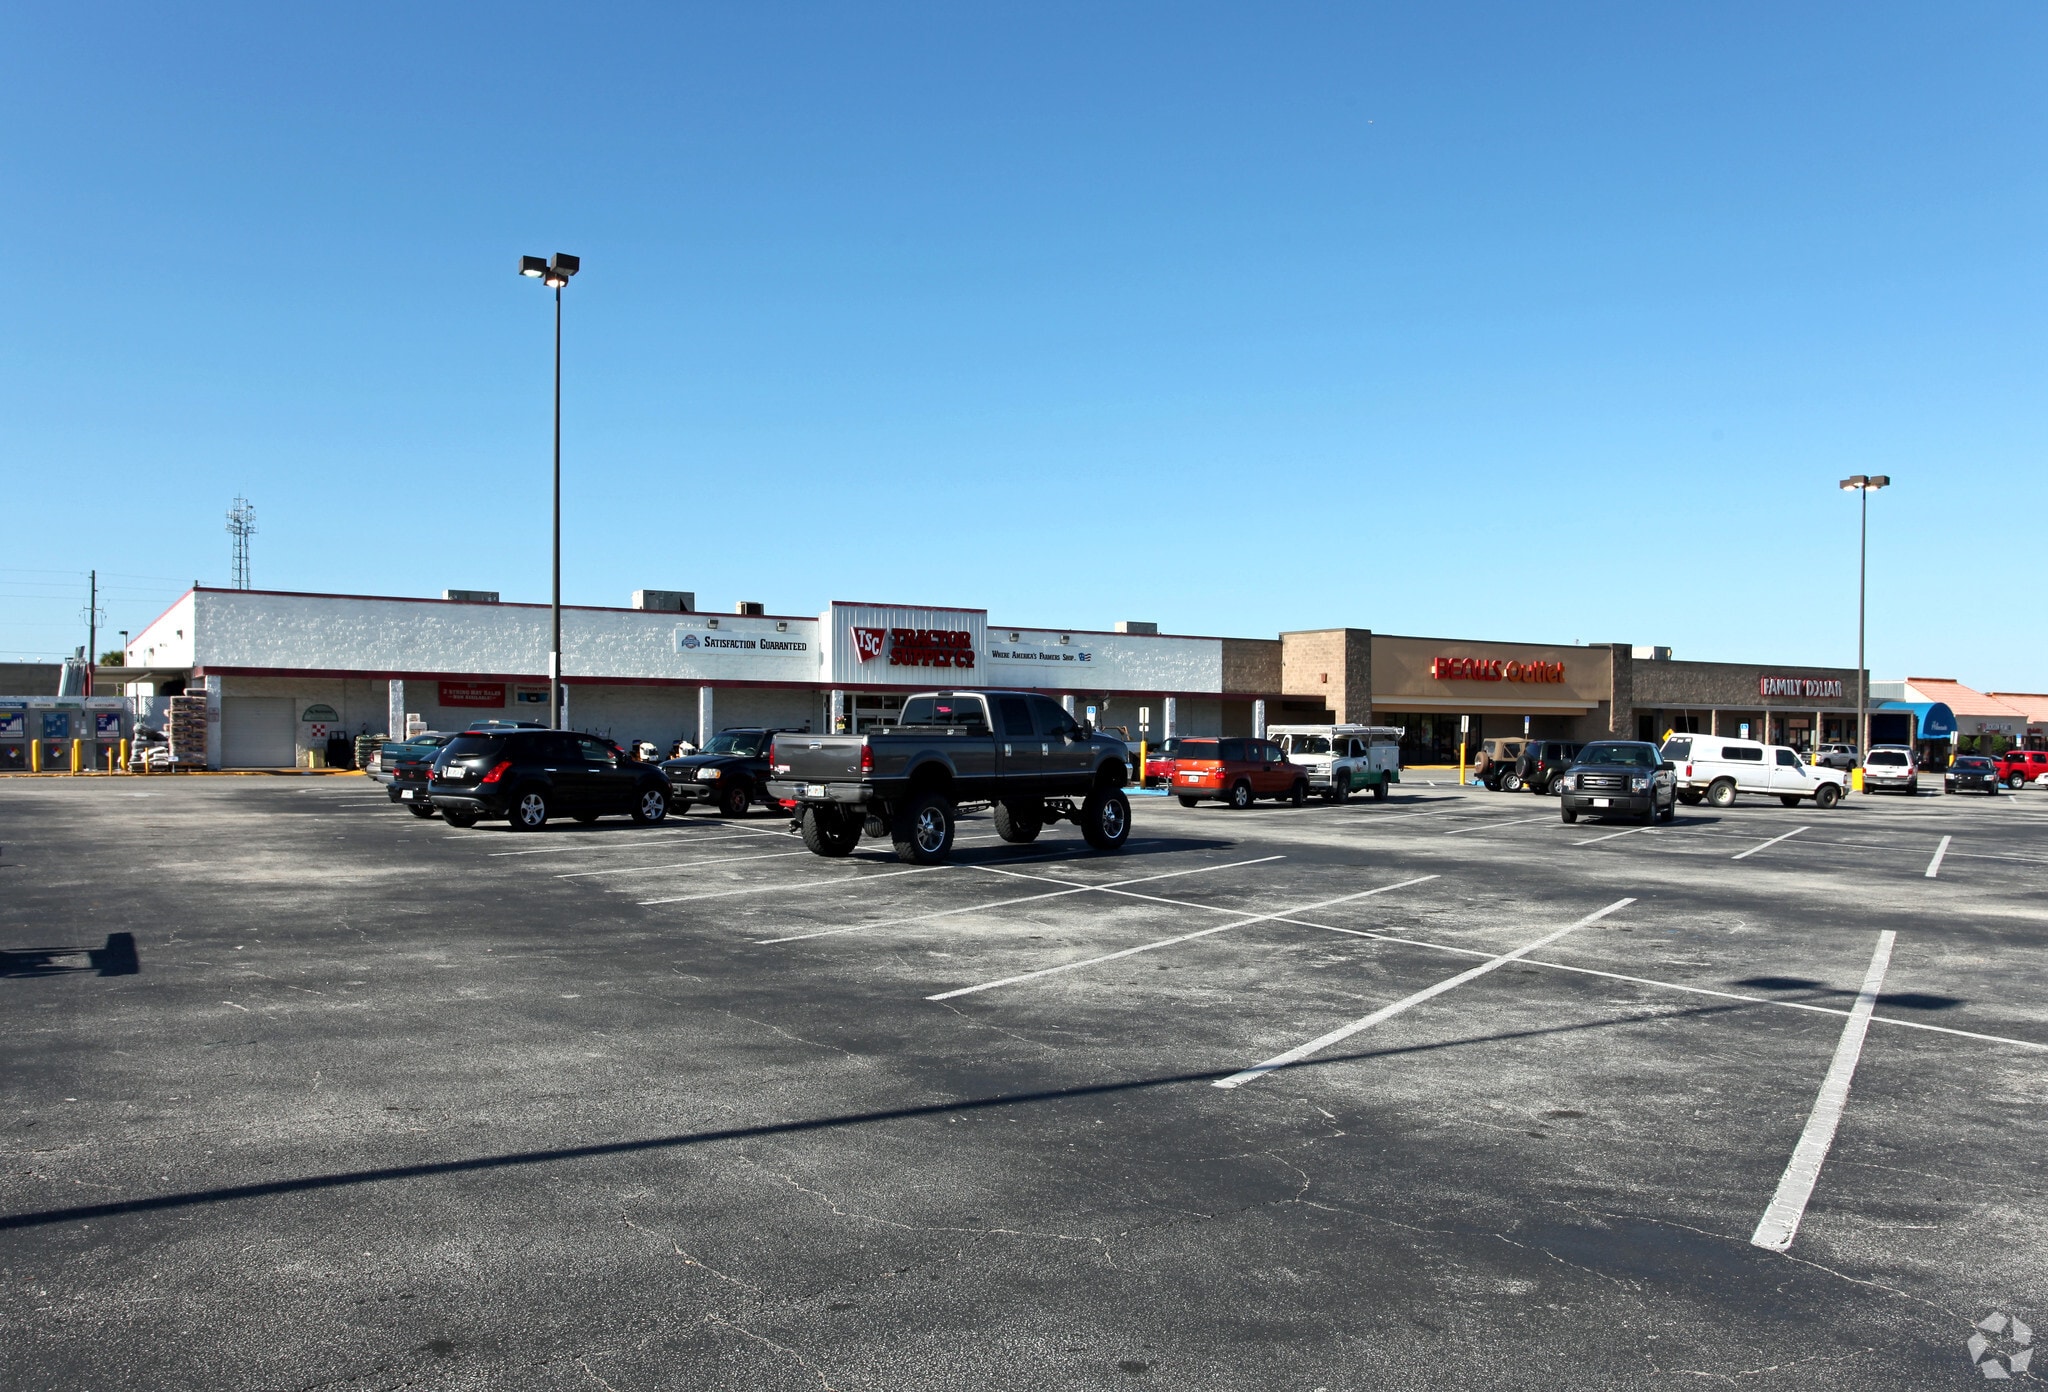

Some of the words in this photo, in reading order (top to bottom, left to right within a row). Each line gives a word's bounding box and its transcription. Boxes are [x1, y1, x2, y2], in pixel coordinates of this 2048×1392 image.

[704, 635, 756, 649] SATISFACTION
[760, 638, 807, 652] GUARANTEED
[857, 629, 880, 656] TSC
[890, 628, 971, 648] TRACTOR
[889, 647, 951, 667] SUPPLY
[991, 650, 1010, 659] WHERE
[1011, 651, 1037, 660] AMERICA'S
[1039, 652, 1060, 661] FARMERS
[1504, 660, 1565, 683] Outlet
[1760, 676, 1801, 697] FAMILY
[1803, 679, 1842, 698] DOLLAR
